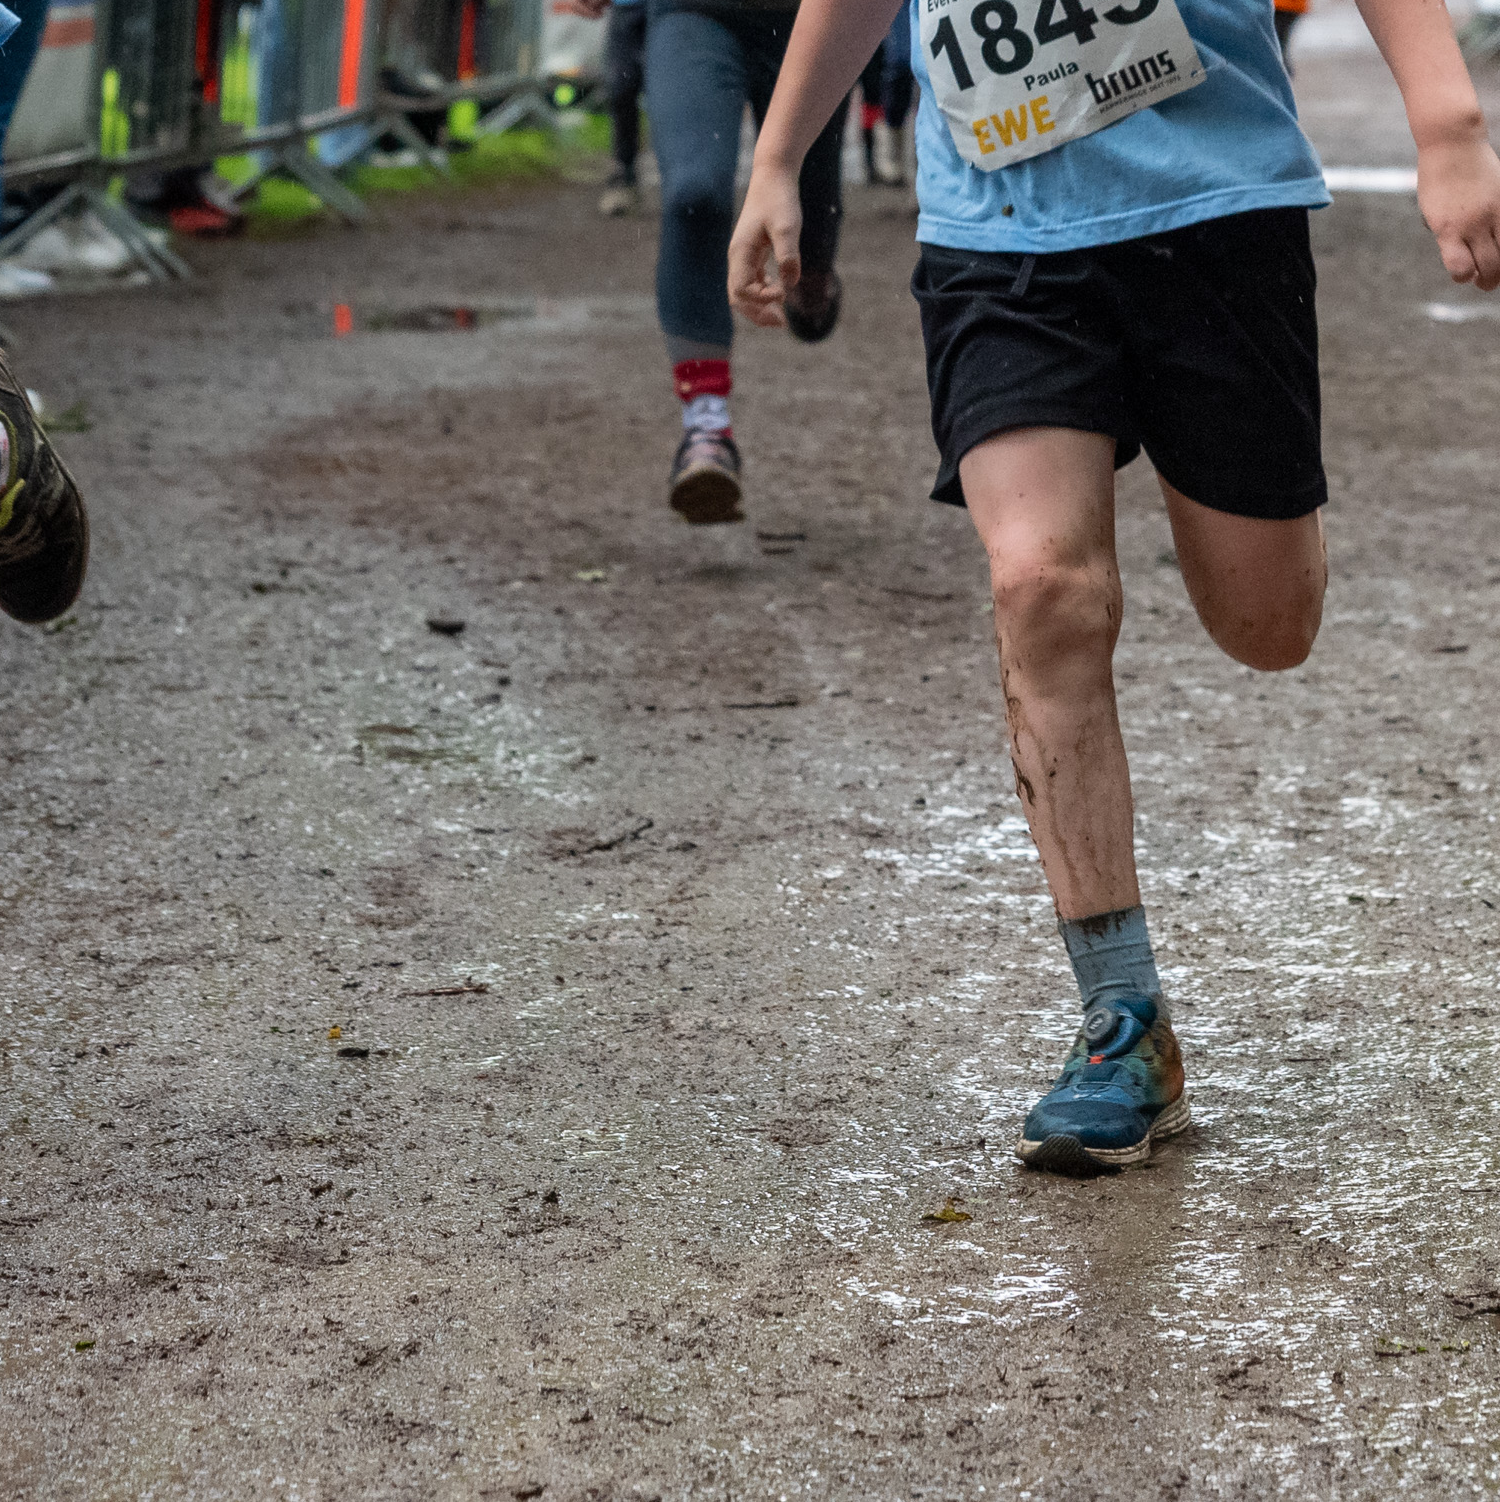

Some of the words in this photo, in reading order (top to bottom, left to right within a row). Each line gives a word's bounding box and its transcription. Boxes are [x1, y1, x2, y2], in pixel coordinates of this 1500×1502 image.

[1023, 59, 1080, 92] Paula
[1084, 49, 1177, 105] bruns
[972, 94, 1056, 156] EWE
